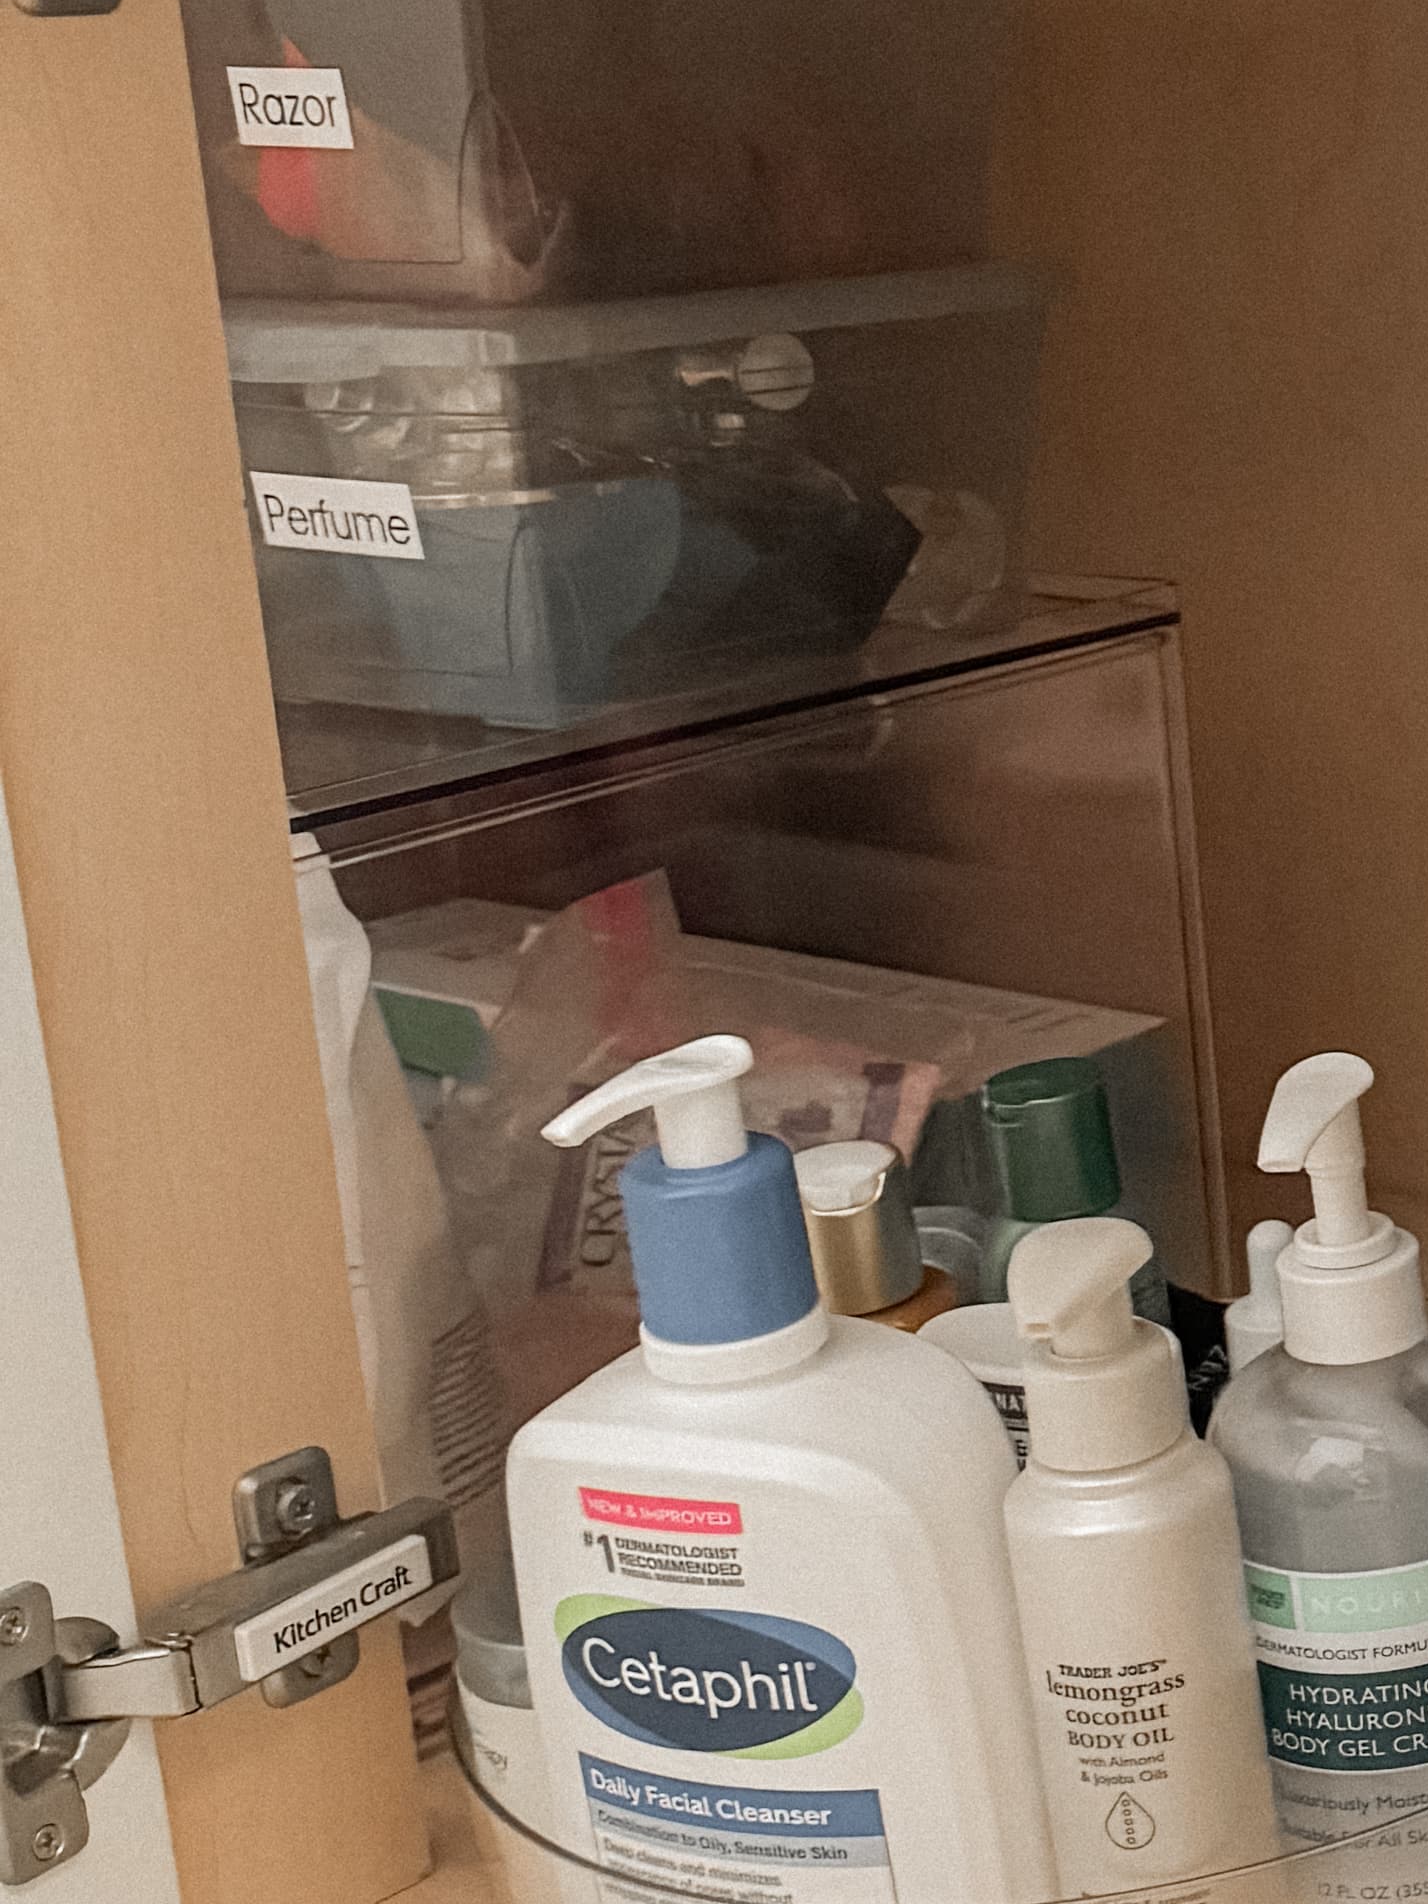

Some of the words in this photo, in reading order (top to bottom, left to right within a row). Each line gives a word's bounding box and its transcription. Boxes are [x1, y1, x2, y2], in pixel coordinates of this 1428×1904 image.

[238, 82, 337, 127] Razor
[263, 494, 411, 545] Perfume
[639, 1507, 733, 1526] IMPROVED
[615, 1537, 739, 1560] DERMATOLOGIST
[617, 1551, 743, 1576] RECOMMENDED
[273, 1596, 357, 1655] Kitchen
[359, 1565, 413, 1609] Craft
[580, 1636, 819, 1719] Cetaphil
[1057, 1663, 1113, 1679] TRADER
[1046, 1669, 1186, 1708] lemongrass
[1065, 1703, 1171, 1726] coconut
[1067, 1729, 1127, 1749] BODY
[1132, 1727, 1176, 1747] OIL
[1271, 1727, 1333, 1757] BODY
[1337, 1739, 1386, 1758] GEL
[590, 1767, 642, 1807] Daily
[645, 1784, 713, 1818] Facial
[715, 1798, 833, 1827] Cleanser
[681, 1832, 697, 1847] to
[699, 1836, 733, 1855] Oily,
[733, 1840, 808, 1860] Sensitive
[811, 1846, 849, 1860] Skin
[1360, 1885, 1391, 1901] OZ
